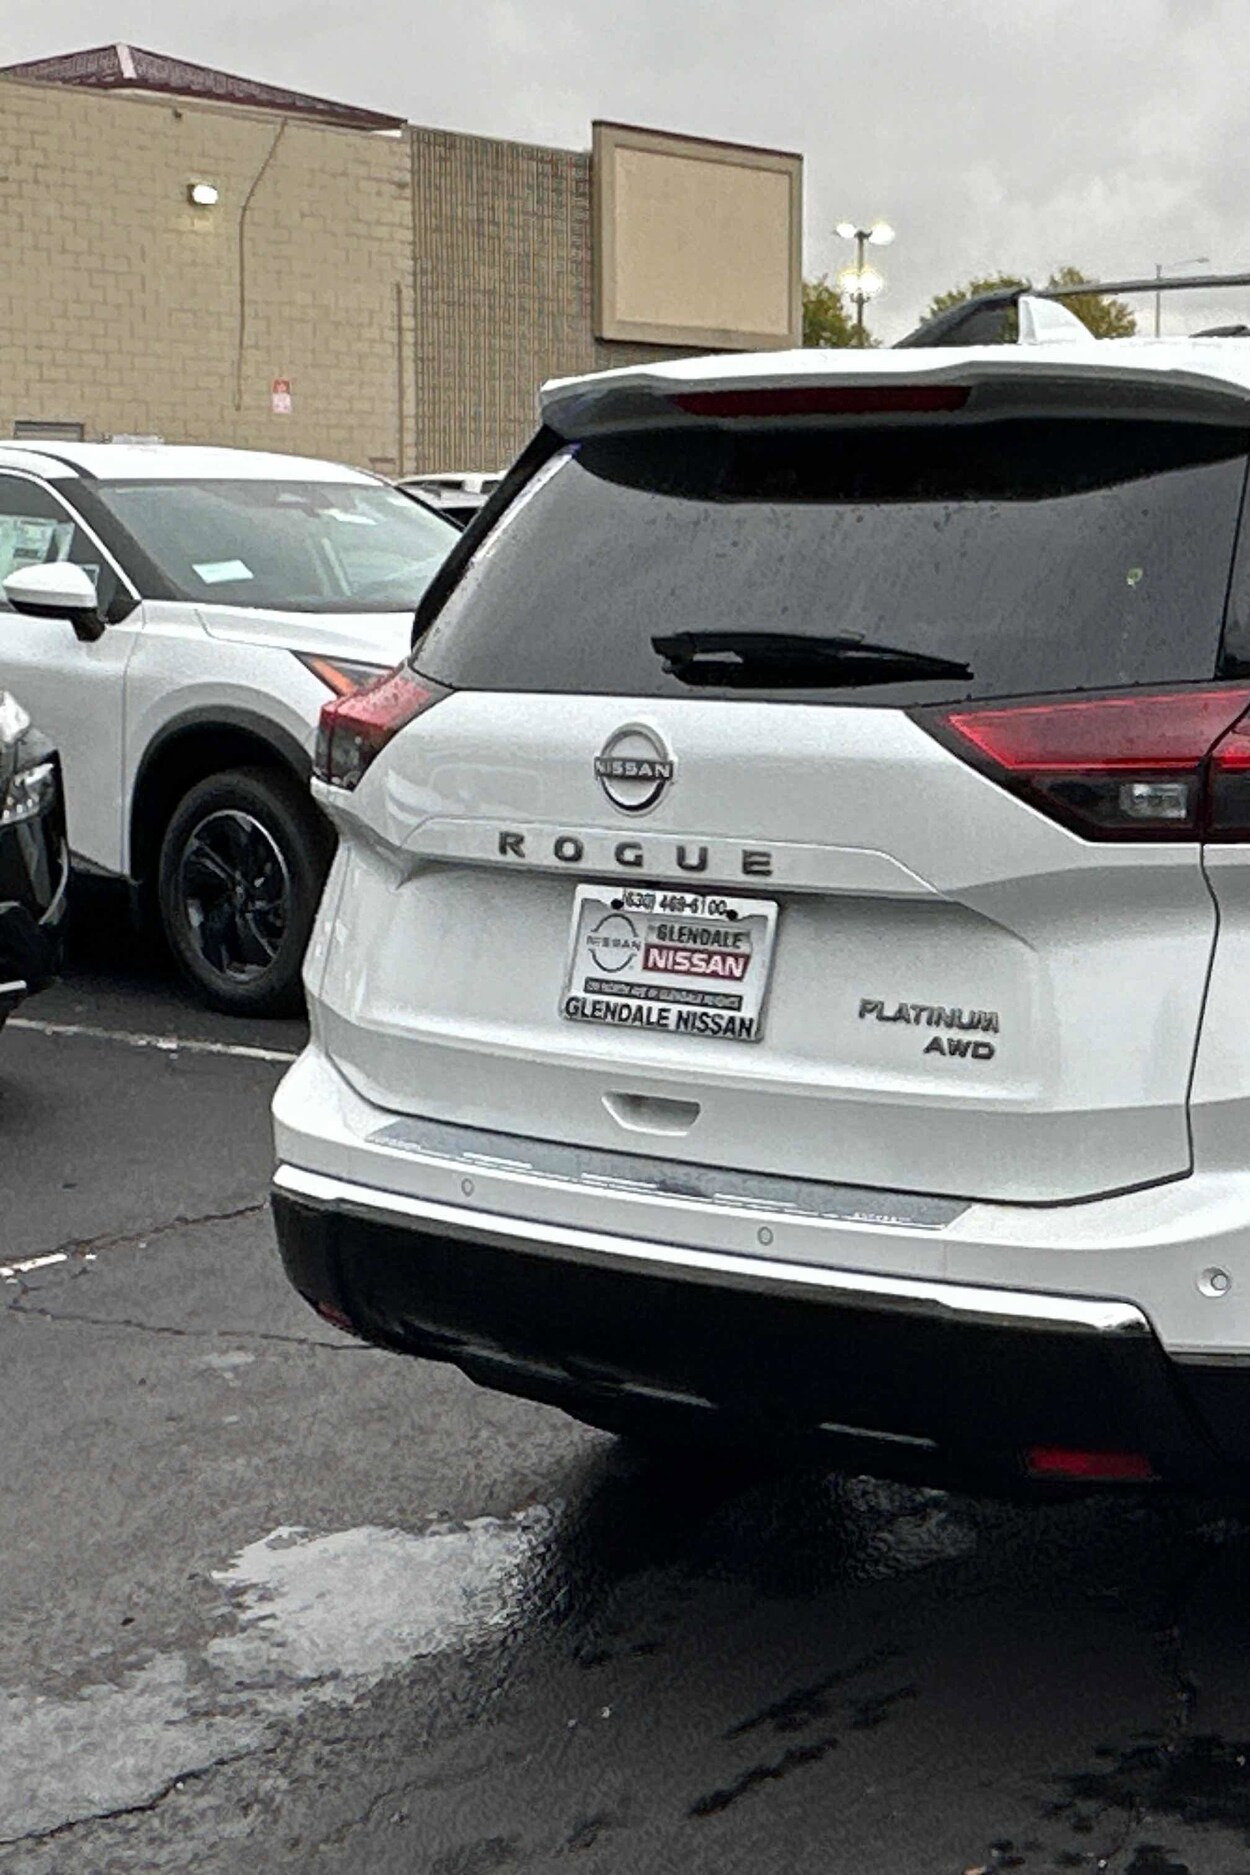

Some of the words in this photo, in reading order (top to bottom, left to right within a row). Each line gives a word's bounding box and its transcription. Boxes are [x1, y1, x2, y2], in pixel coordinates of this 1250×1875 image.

[595, 760, 671, 777] NISSAN
[498, 831, 773, 876] ROGUE
[656, 924, 743, 949] GLENDALE
[647, 948, 745, 978] NISSAN
[565, 997, 671, 1029] GLENDALE
[675, 1009, 755, 1038] NISSAN
[858, 998, 1000, 1033] PLATINUM
[923, 1036, 996, 1060] AWD
